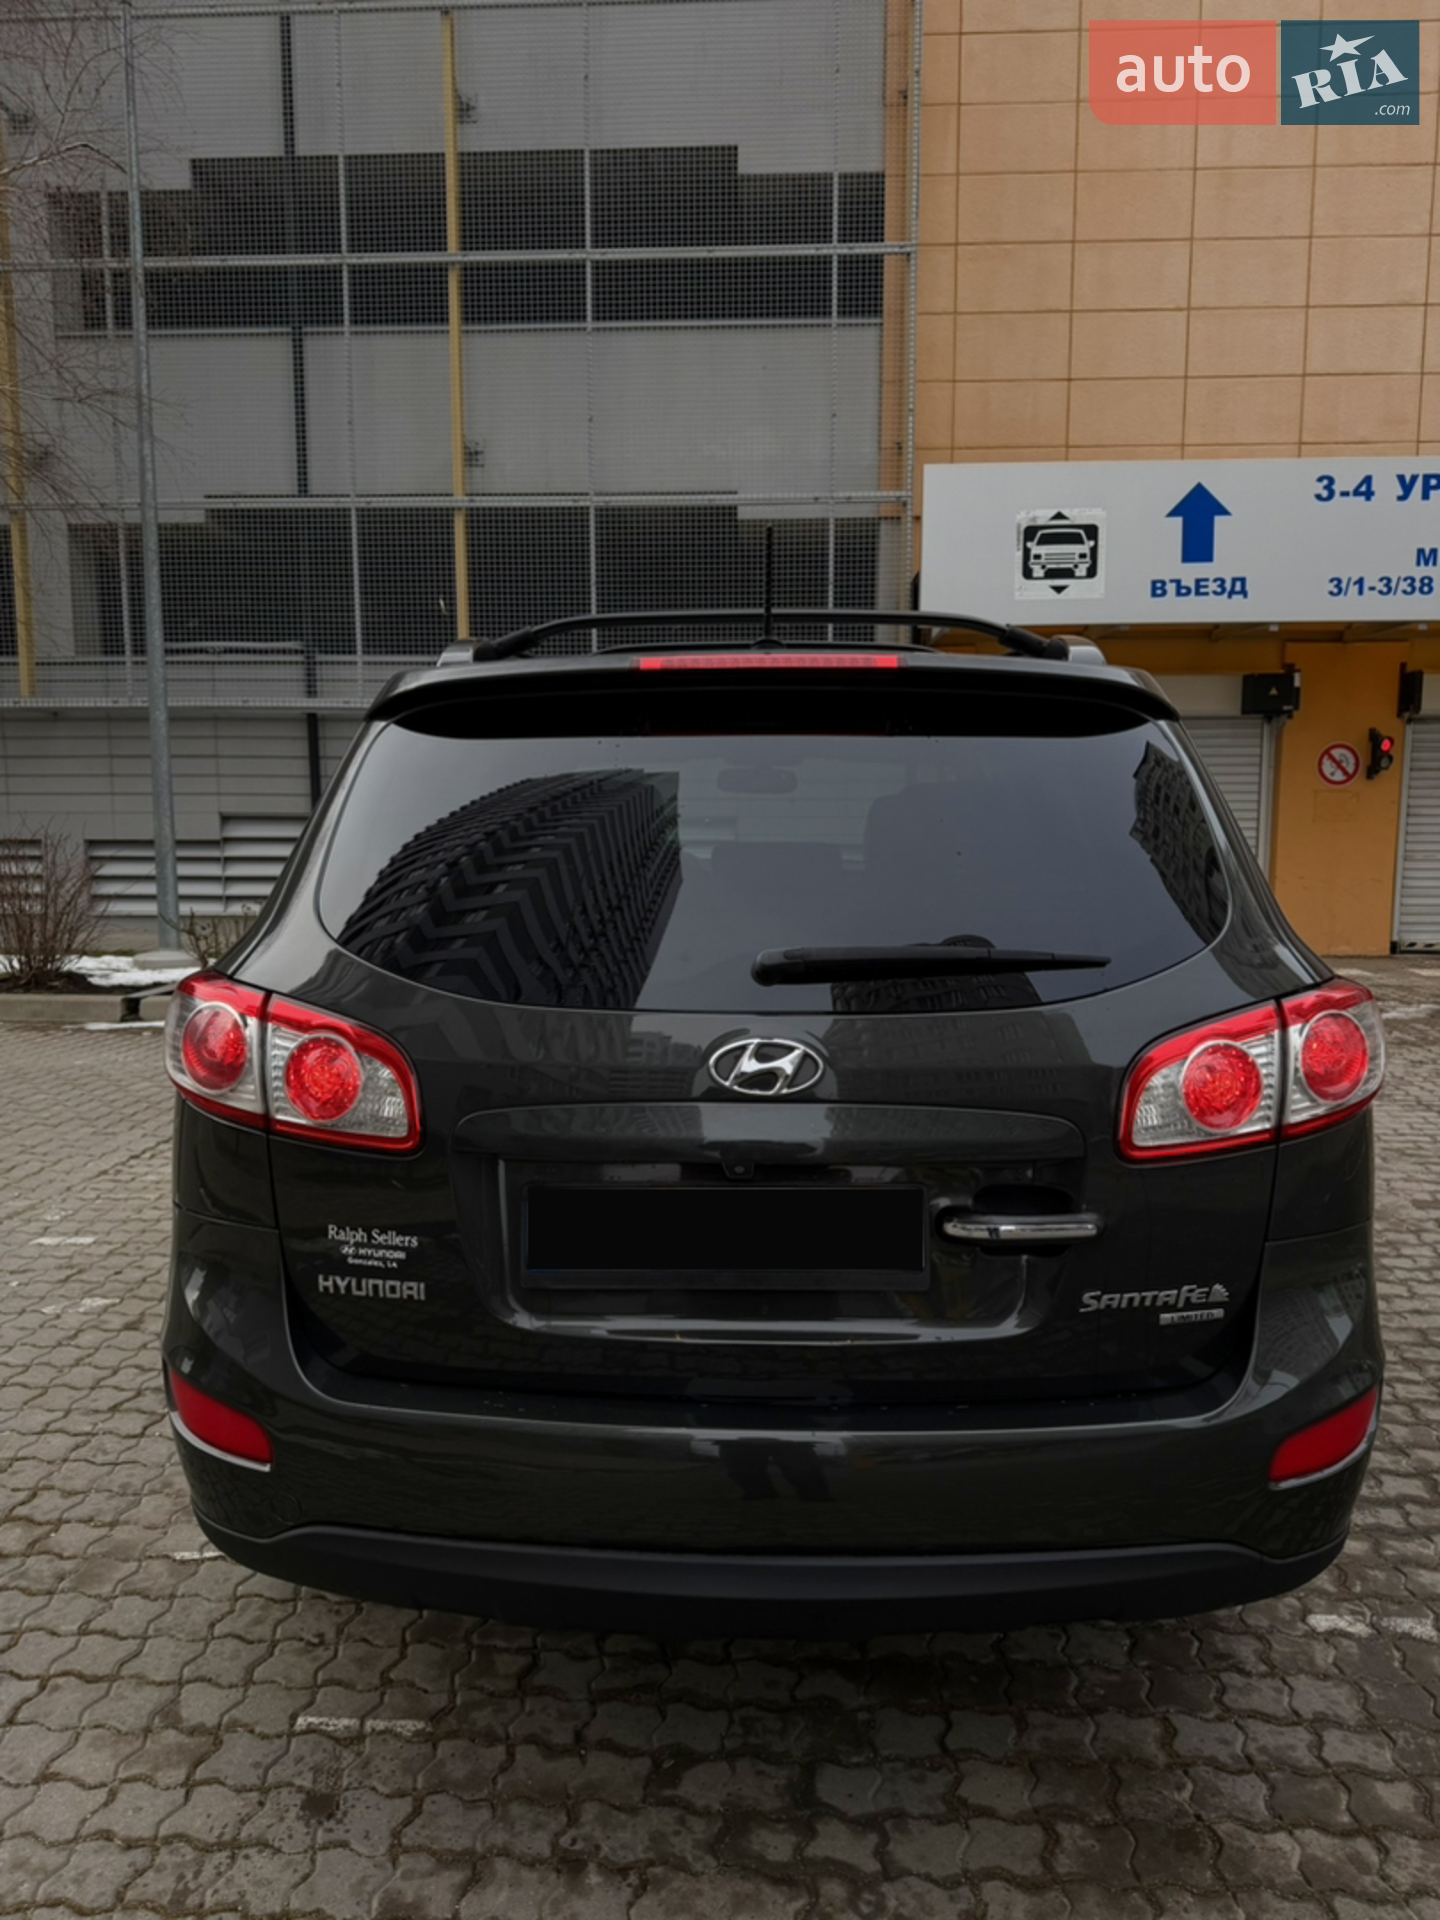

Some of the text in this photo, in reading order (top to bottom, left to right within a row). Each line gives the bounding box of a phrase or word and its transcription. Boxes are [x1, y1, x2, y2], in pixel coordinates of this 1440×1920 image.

[1313, 474, 1376, 502] 3-4
[1150, 576, 1249, 600] ВЪЕЗД
[1327, 575, 1435, 598] 3/1-3/38
[327, 1223, 419, 1248] Ralph Sellers
[317, 1273, 426, 1301] HYUNDAI
